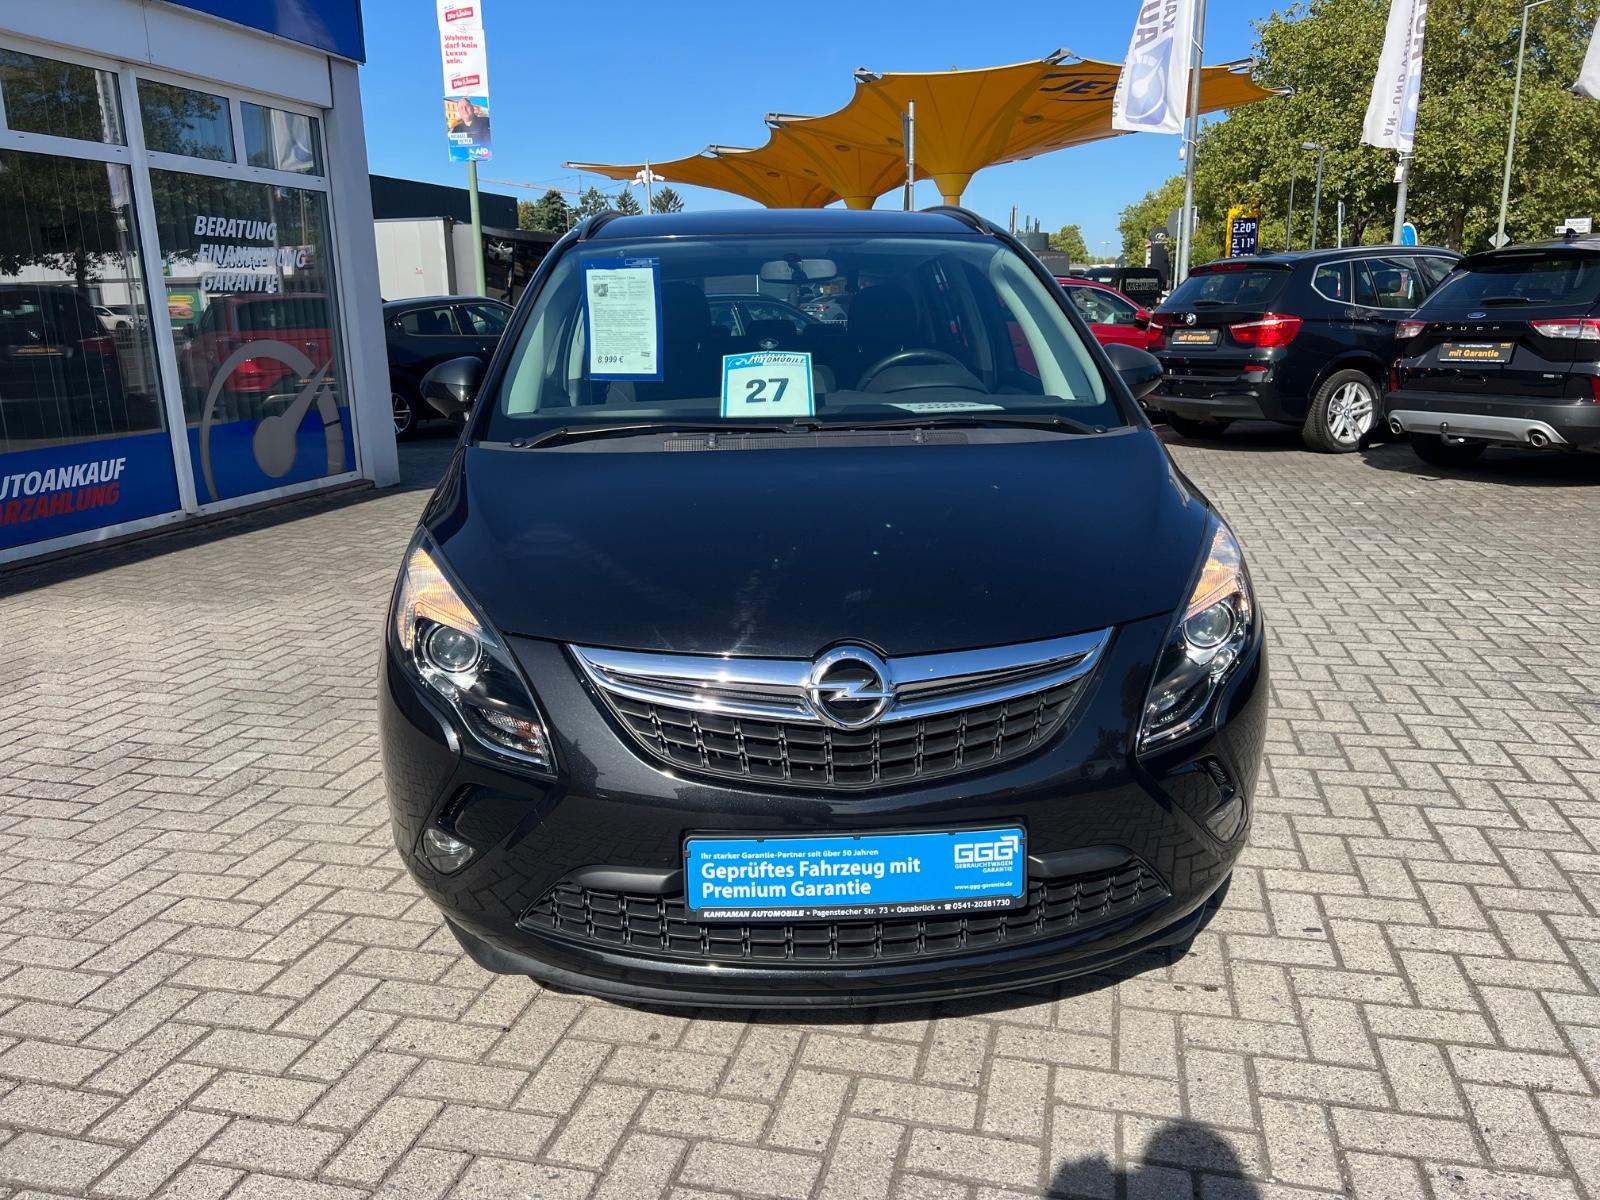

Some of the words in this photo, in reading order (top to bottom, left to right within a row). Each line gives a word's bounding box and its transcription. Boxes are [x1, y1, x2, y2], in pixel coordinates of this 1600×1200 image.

[194, 215, 278, 241] BERATUNG
[202, 272, 279, 293] GARANTIE
[751, 356, 805, 364] AUTOMOBILE
[1449, 349, 1463, 357] mit
[1463, 349, 1500, 358] Garantie
[745, 377, 789, 403] 27
[700, 852, 712, 860] Ihr
[713, 851, 740, 859] starker
[741, 850, 806, 859] Garantie-Partner
[807, 850, 821, 858] seit
[822, 849, 840, 857] über
[853, 849, 879, 857] Jahren
[954, 841, 1014, 864] GGG
[701, 861, 794, 883] Geprüftes
[799, 860, 885, 879] Fahrzeug
[889, 857, 921, 874] mit
[954, 861, 1013, 869] GEBRAUCHTWAGEN
[982, 866, 1013, 874] GARANTIE
[702, 882, 787, 899] Premium
[790, 879, 872, 898] Garantie
[954, 881, 1013, 890] www.ggg-garantie.de
[703, 910, 750, 918] KAHRAMAN
[751, 909, 804, 918] AUTOMOBILE
[812, 908, 861, 917] Pagenstecher
[863, 907, 877, 915] Str.
[878, 906, 889, 914] 73
[896, 904, 935, 913] Osnabrück
[952, 899, 1011, 909] 0541-20281730
